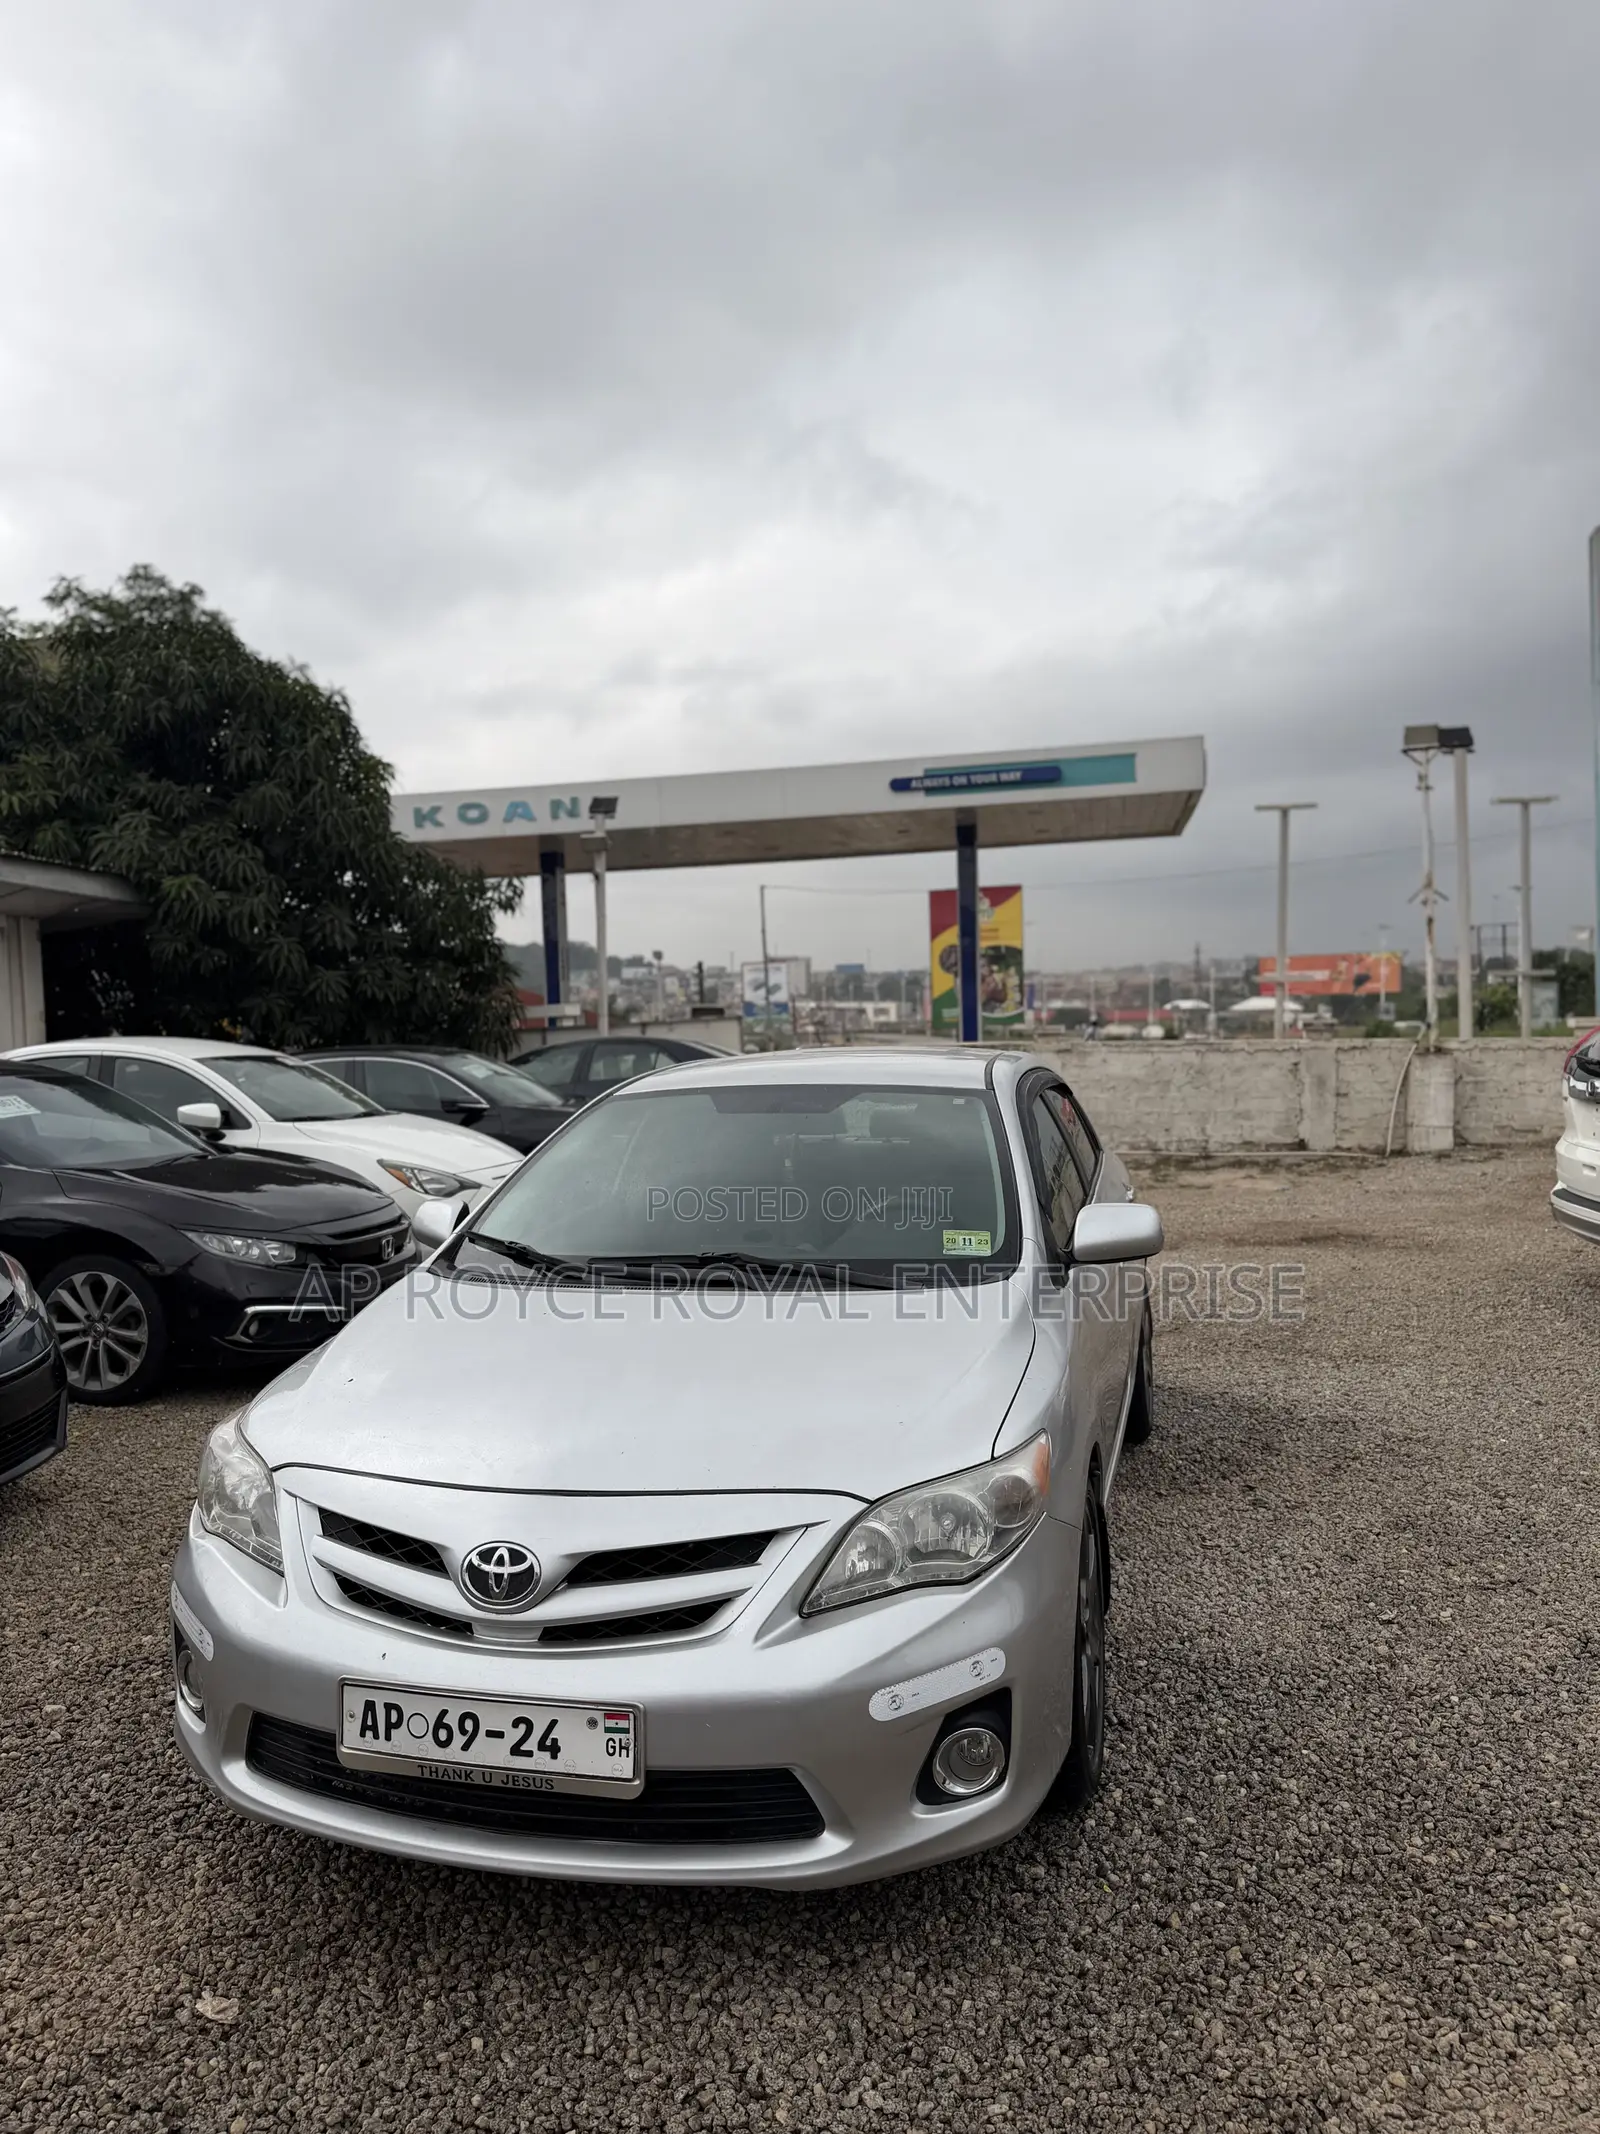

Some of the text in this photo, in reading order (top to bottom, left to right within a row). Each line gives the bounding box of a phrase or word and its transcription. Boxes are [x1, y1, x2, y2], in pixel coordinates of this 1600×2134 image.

[911, 770, 1022, 788] ALWAYS ON YOUR WAY
[413, 797, 580, 828] KOAN
[961, 1237, 973, 1246] 11
[605, 1737, 630, 1758] GH
[417, 1764, 555, 1791] THANK U JESUS
